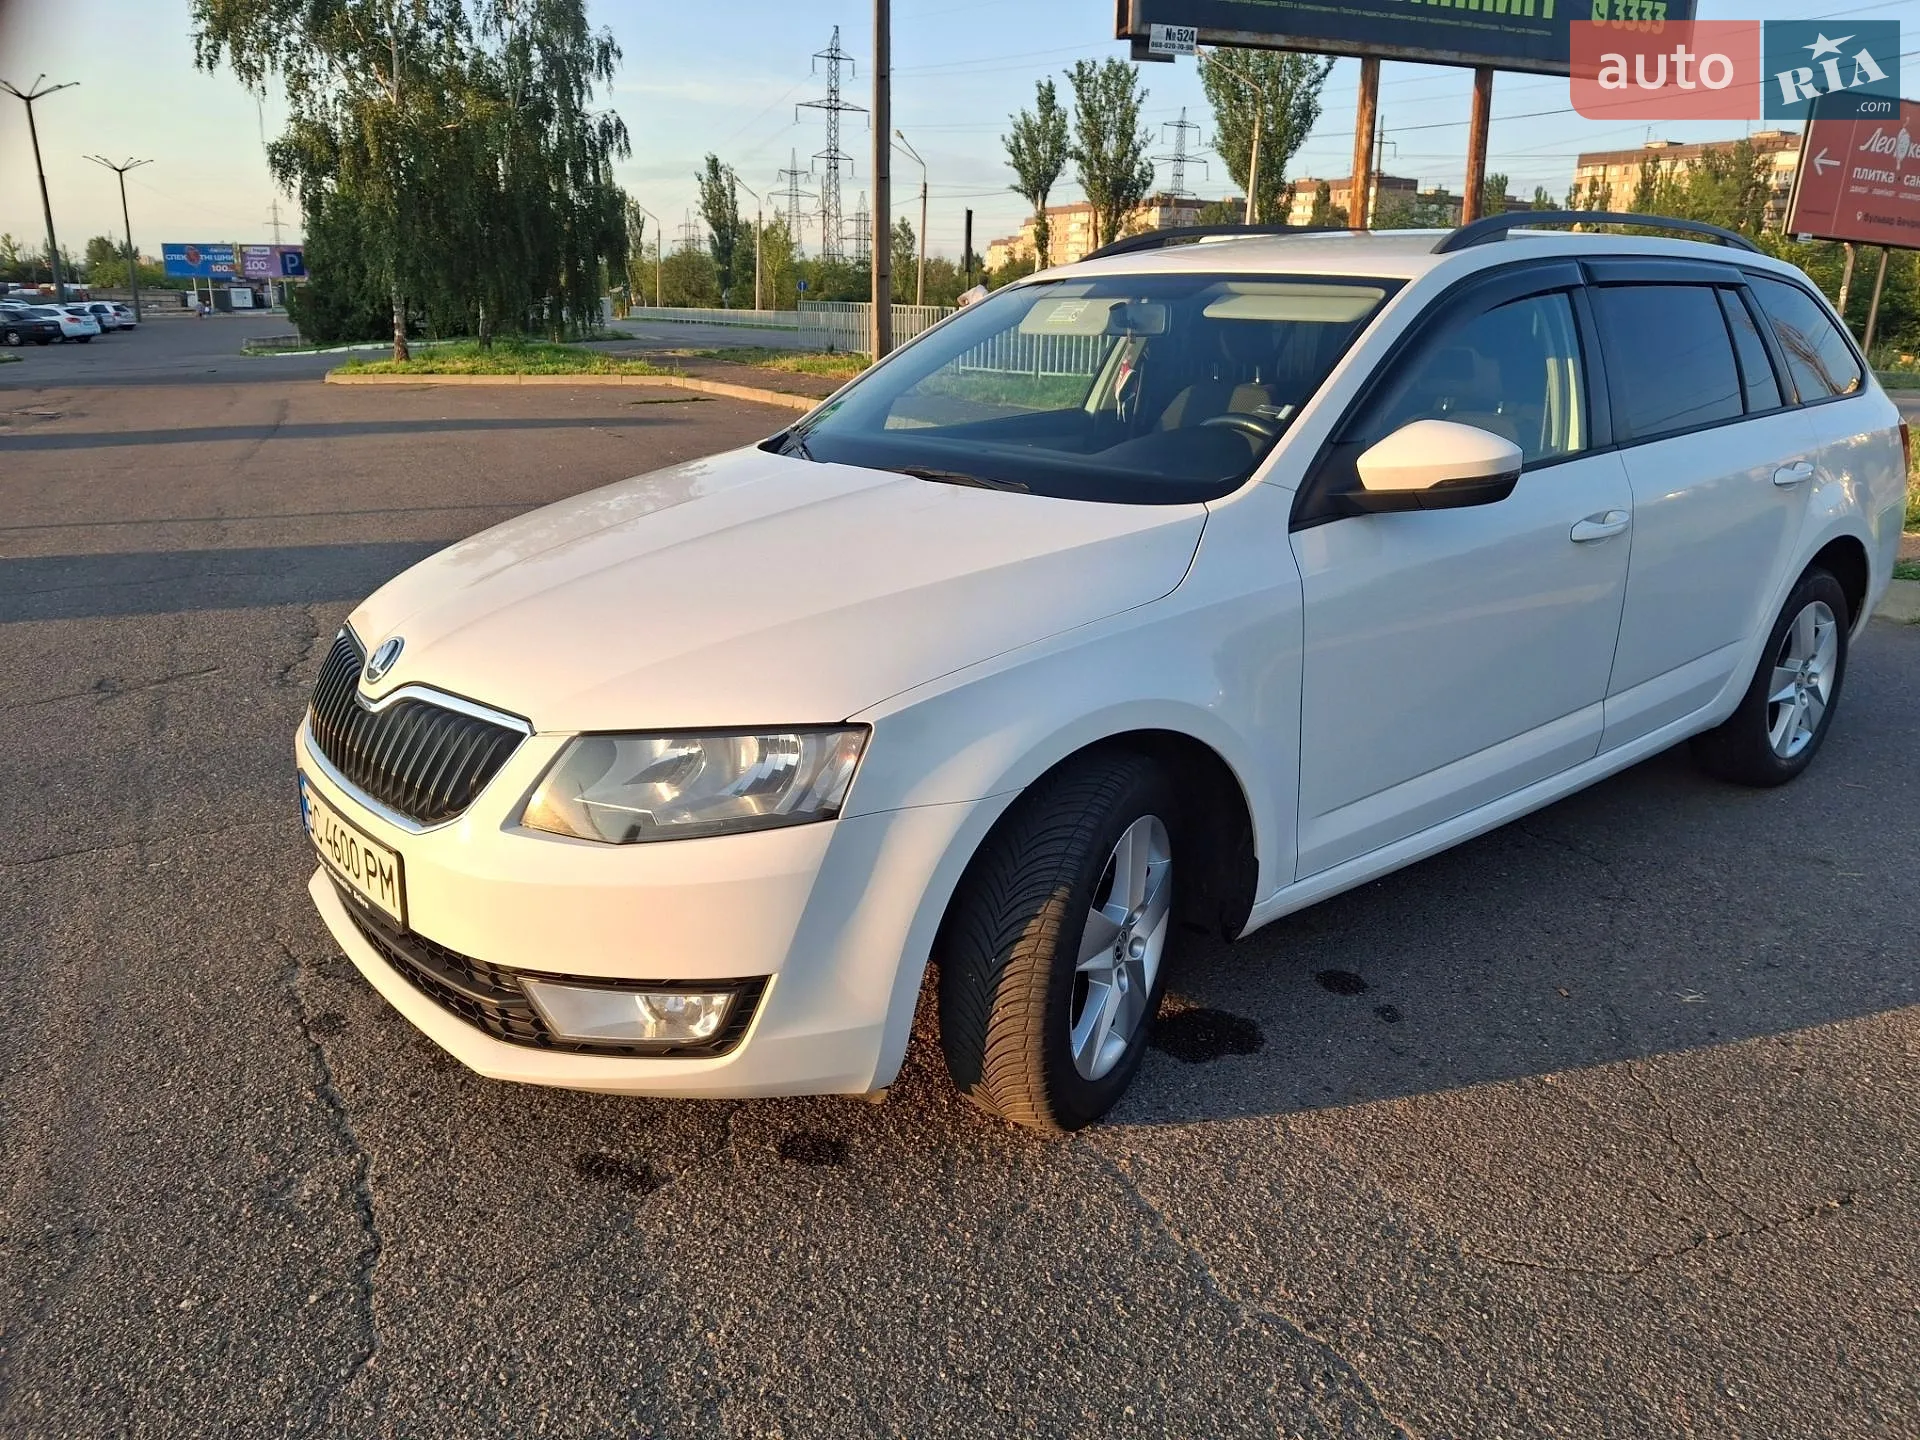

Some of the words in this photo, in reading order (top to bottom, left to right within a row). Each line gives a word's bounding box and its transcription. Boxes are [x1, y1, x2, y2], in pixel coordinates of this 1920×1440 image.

[1611, 0, 1667, 34] 3333
[1853, 167, 1895, 183] плитка
[326, 818, 360, 880] 4600
[364, 847, 396, 908] PM
